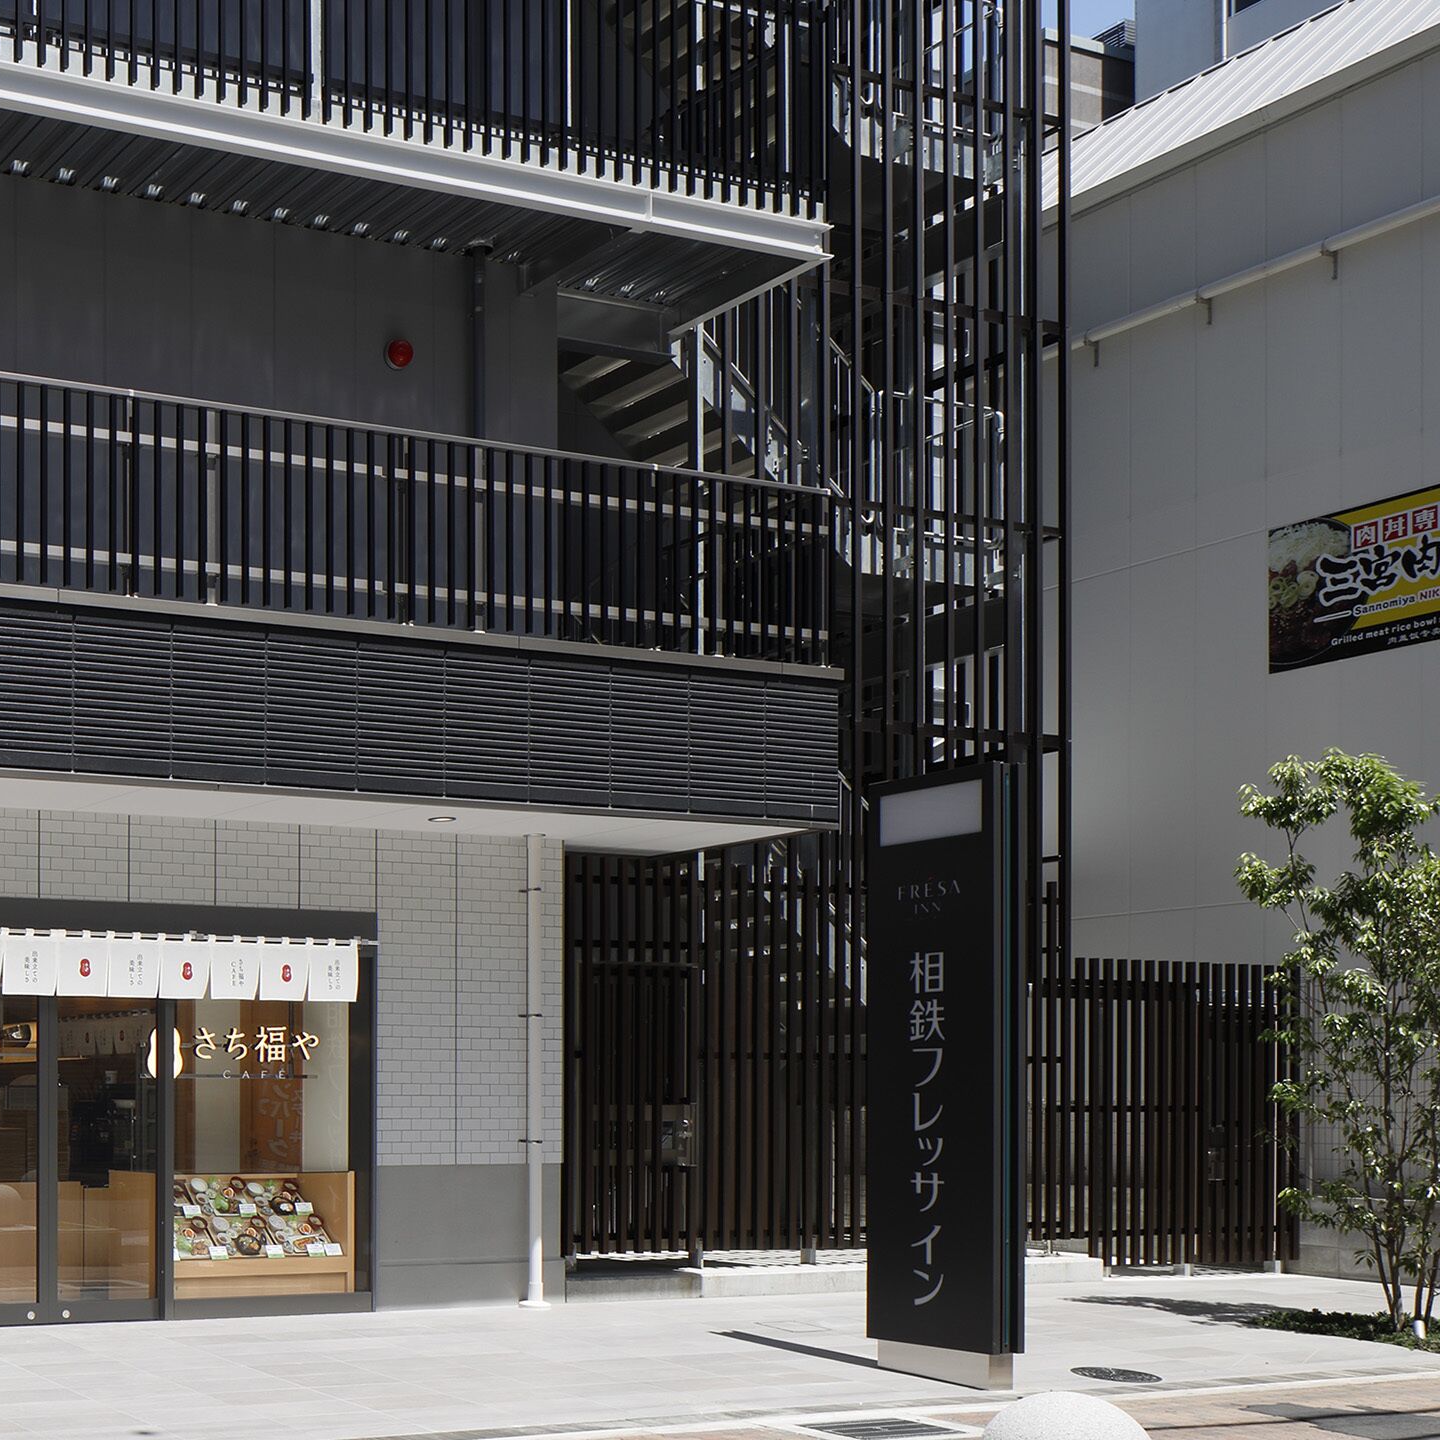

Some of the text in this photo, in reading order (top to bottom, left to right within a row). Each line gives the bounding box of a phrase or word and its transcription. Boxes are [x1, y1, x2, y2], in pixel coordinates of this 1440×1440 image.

[1355, 508, 1437, 548] 肉丼専
[1353, 594, 1416, 616] Sannomiya
[1331, 631, 1364, 646] Grilled
[1365, 626, 1390, 638] meat
[1391, 624, 1412, 633] rice
[1413, 616, 1437, 628] bowl
[914, 902, 941, 914] INN
[194, 1026, 319, 1063] さち福や
[222, 1068, 286, 1079] CAFÉ
[910, 951, 945, 1307] 相鉄フレッサイン
